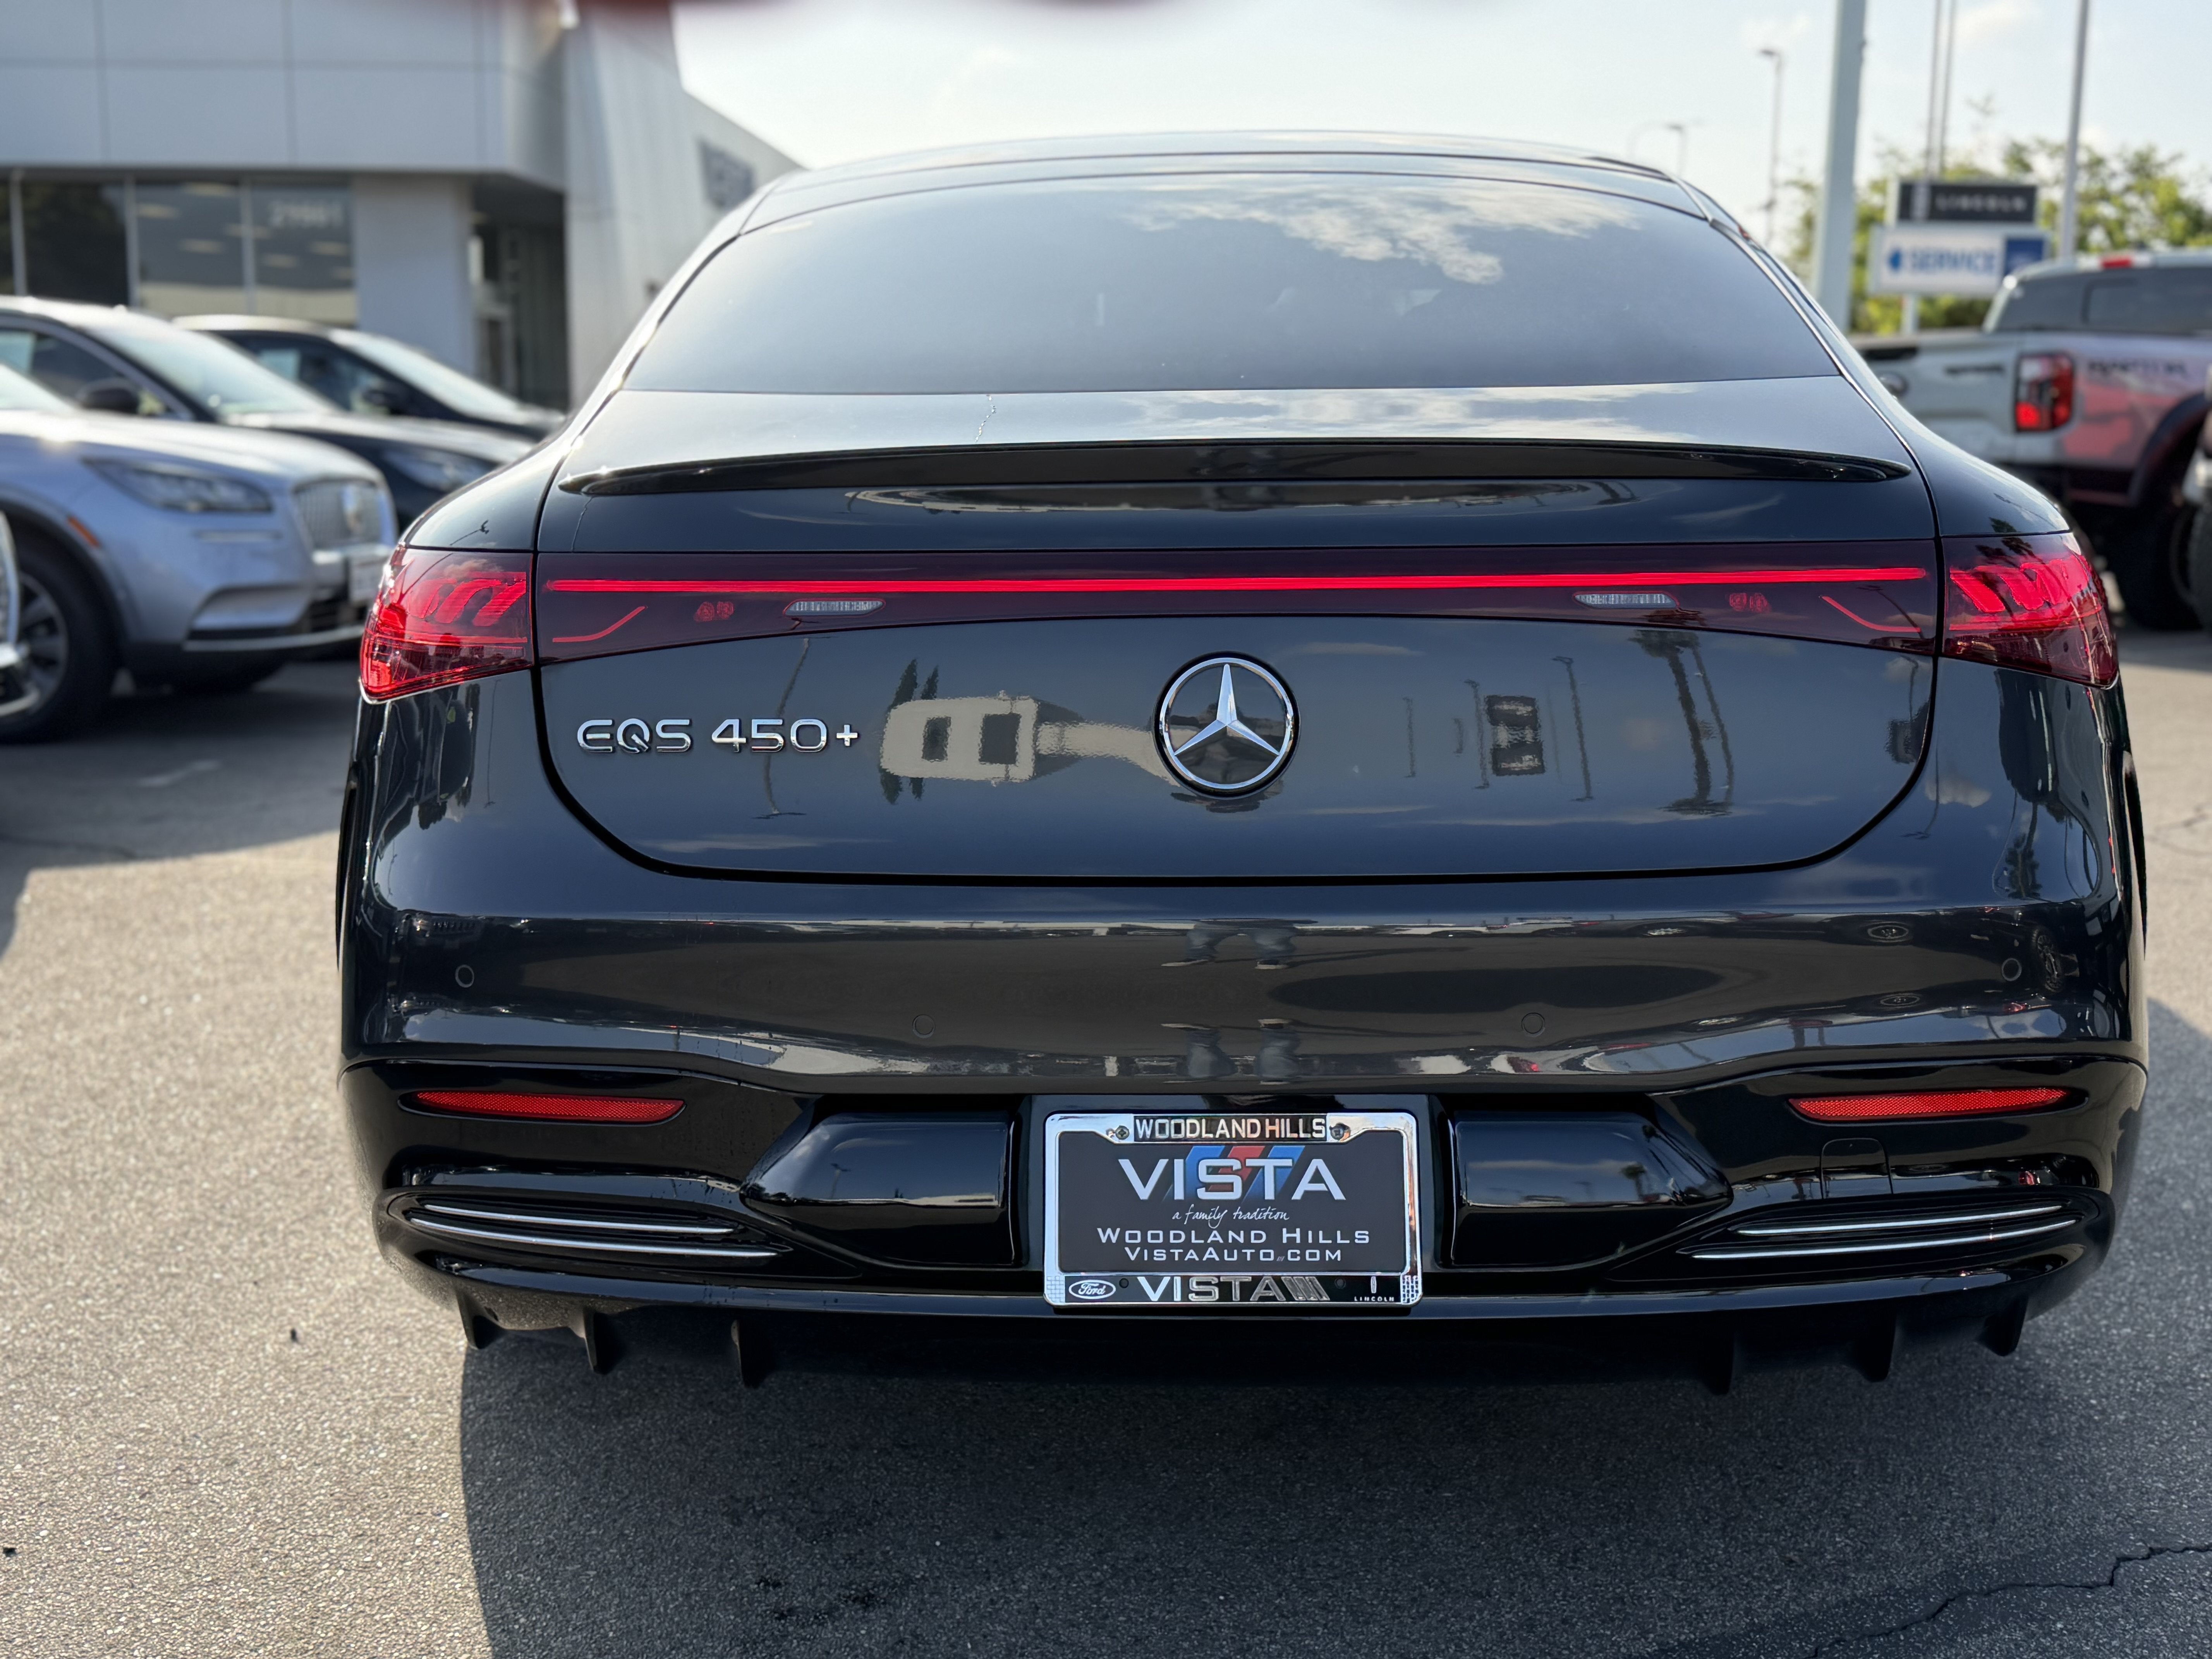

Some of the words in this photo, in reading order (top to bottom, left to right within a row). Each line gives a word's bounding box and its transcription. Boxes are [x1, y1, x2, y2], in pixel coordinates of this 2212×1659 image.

[1911, 247, 1998, 274] SERVICE
[577, 718, 691, 754] EQS
[711, 718, 858, 753] 450+
[1135, 1118, 1260, 1139] WOODLAND
[1265, 1118, 1326, 1138] HILLS
[1118, 1159, 1346, 1200] VISTA
[1184, 1204, 1228, 1228] family
[1233, 1206, 1290, 1221] tradition
[1078, 1283, 1106, 1295] Ford
[1137, 1276, 1286, 1302] VISTA
